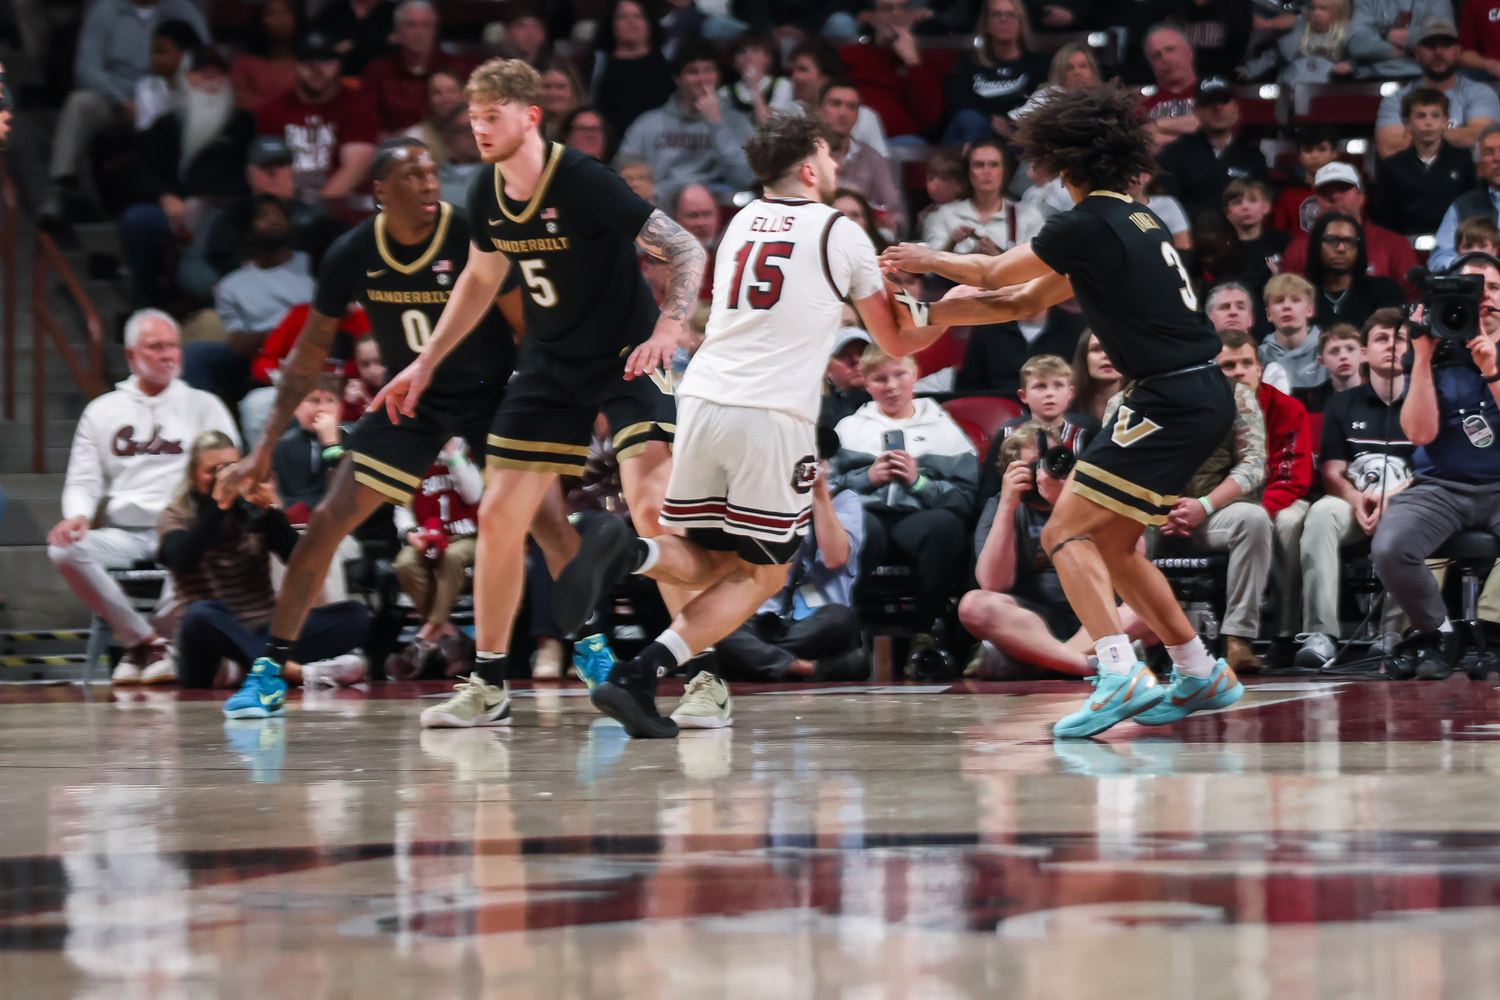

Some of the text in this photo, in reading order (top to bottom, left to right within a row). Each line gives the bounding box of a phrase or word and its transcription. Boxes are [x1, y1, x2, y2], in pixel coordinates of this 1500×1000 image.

[491, 236, 569, 254] VANDERBILT
[750, 215, 796, 233] ELLIS
[519, 257, 559, 308] 5
[726, 240, 796, 310] 15
[1160, 240, 1198, 312] 3
[401, 308, 433, 354] 0
[437, 493, 450, 522] 1
